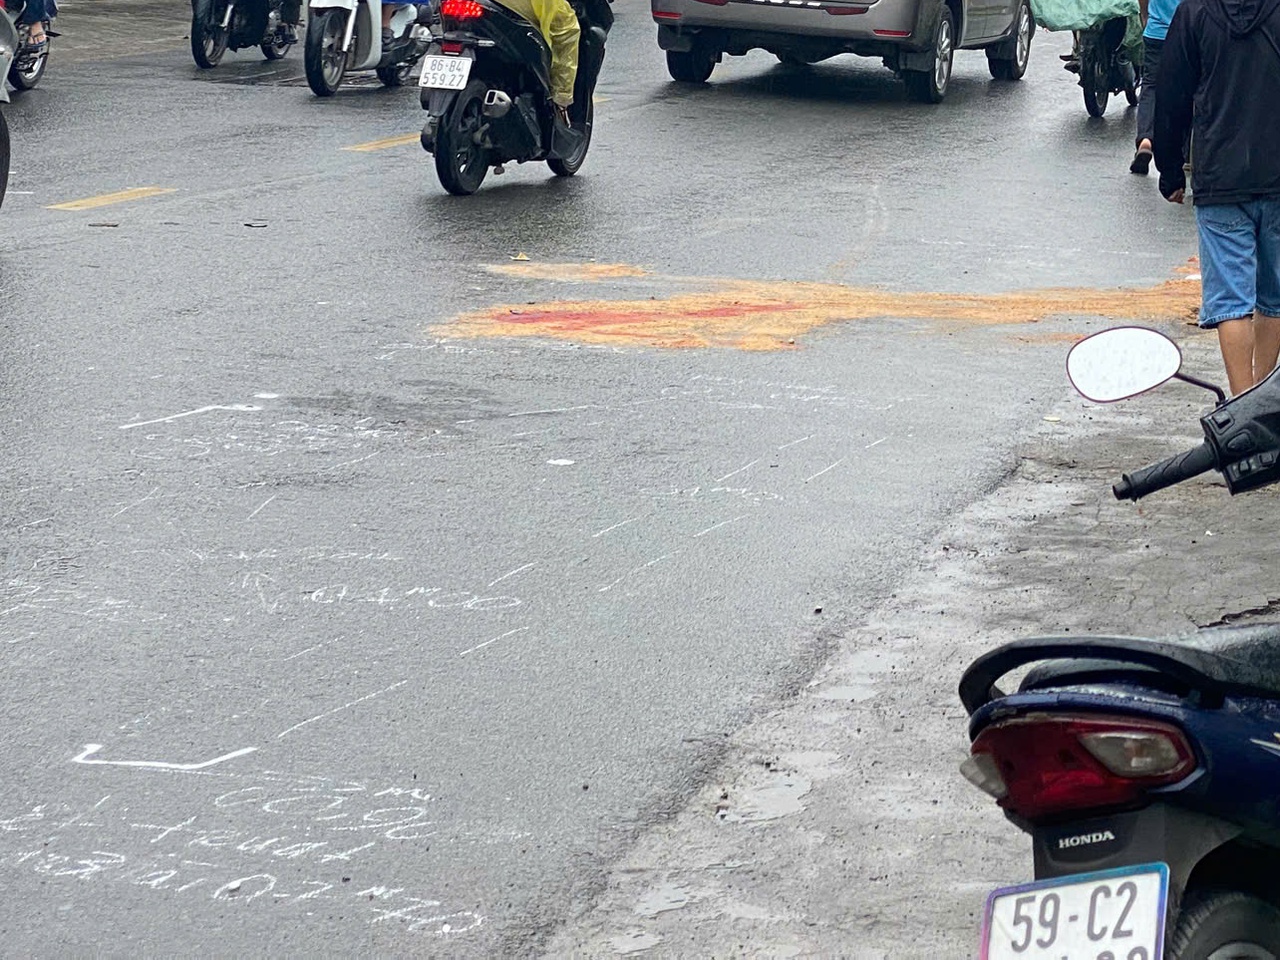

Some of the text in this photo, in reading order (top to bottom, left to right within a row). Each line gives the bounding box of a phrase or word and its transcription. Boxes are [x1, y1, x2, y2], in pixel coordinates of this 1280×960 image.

[423, 73, 464, 87] 559.27
[1058, 829, 1115, 849] HONDA
[1011, 881, 1138, 953] 59-C2
